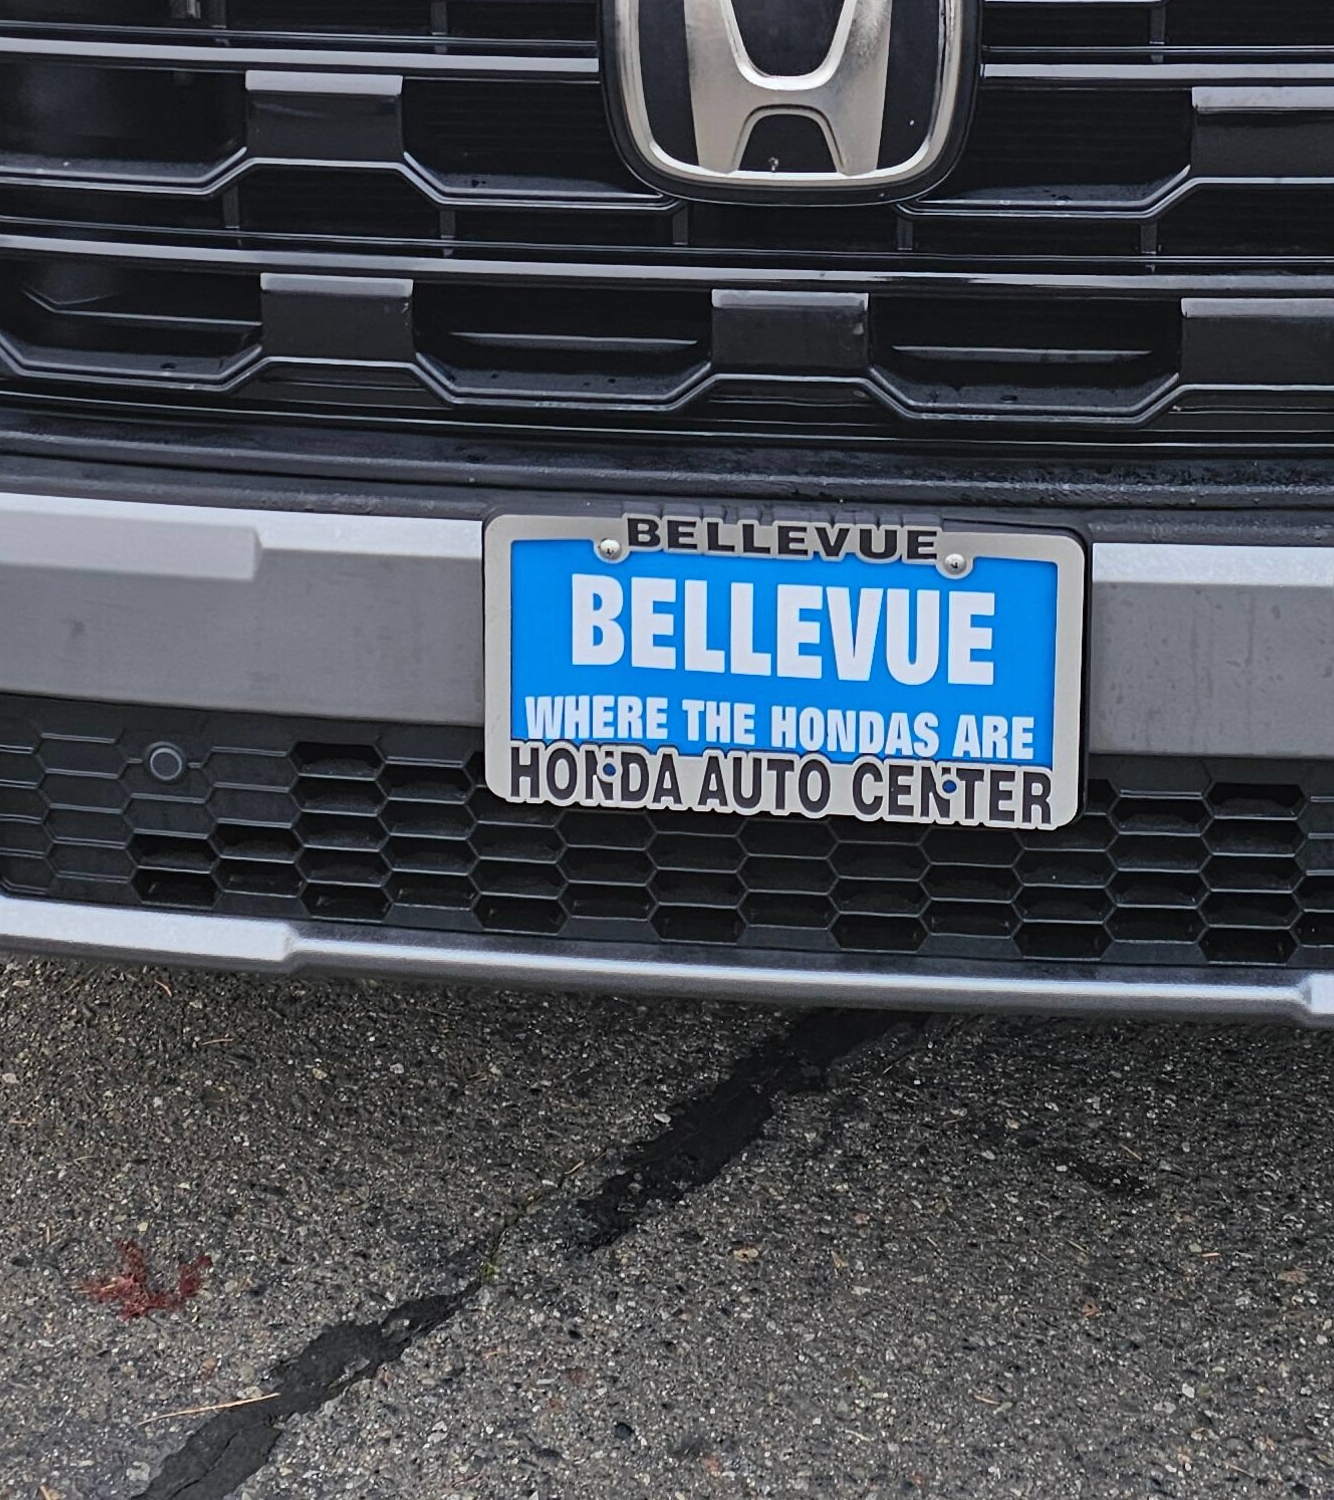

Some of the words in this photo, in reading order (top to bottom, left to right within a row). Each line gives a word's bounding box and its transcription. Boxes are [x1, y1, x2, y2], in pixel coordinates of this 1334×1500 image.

[626, 517, 938, 560] BELLEVUE
[571, 573, 996, 686] BELLEVUE
[524, 694, 668, 740] WHERE
[681, 699, 756, 746] THE
[770, 704, 940, 758] HONDAS
[951, 714, 1036, 760] ARE
[510, 745, 684, 805] HONDA
[697, 754, 832, 813] AUTO
[851, 762, 1053, 826] CENTER
